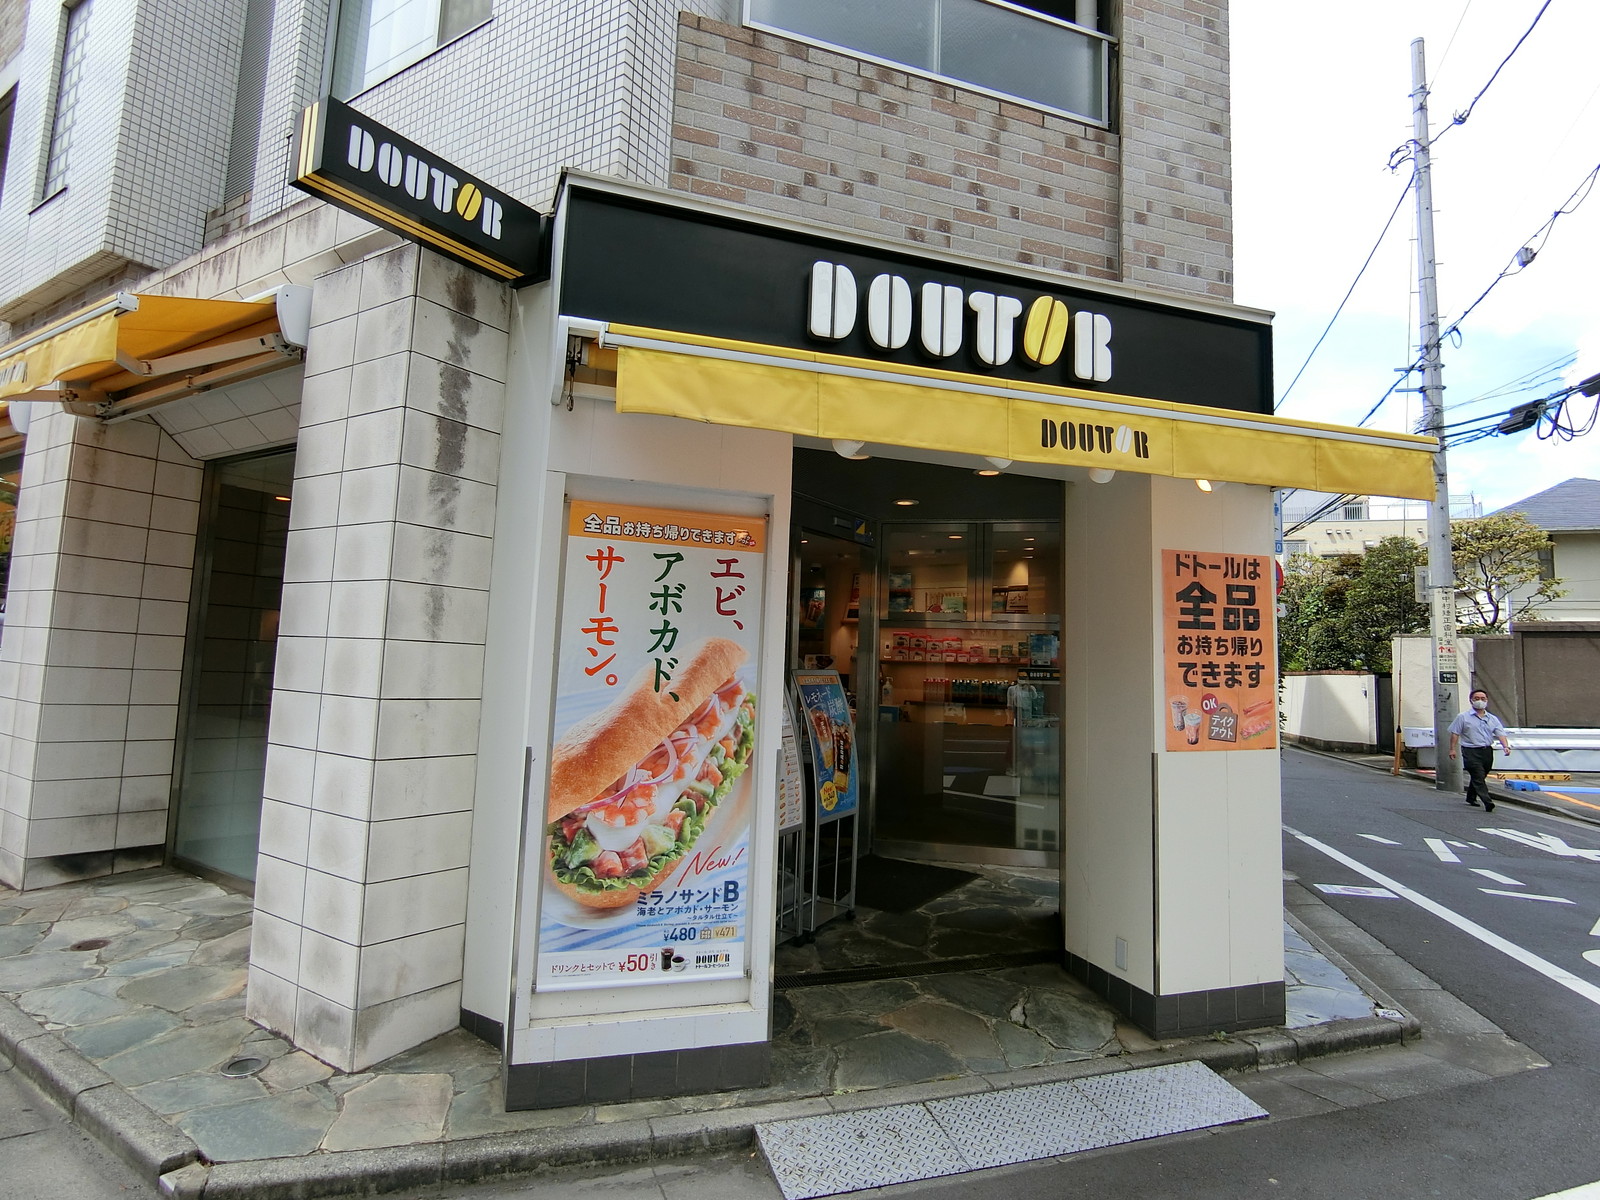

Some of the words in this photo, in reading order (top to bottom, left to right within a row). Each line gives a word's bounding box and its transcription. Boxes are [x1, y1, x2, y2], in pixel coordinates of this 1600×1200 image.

[347, 124, 503, 241] DOUTOR
[808, 260, 1113, 383] DOUTOR
[1041, 418, 1150, 459] DOUTOR
[584, 513, 736, 545] 全品お持ち帰りできます
[1175, 553, 1261, 580] ドトールは
[710, 558, 746, 631] エビ、
[1175, 581, 1261, 632] 全品
[581, 545, 626, 687] サーモン。
[646, 552, 687, 702] アボカド、
[1177, 634, 1264, 657] お持ち帰り
[1177, 661, 1266, 689] できます
[1203, 697, 1217, 711] OK
[1211, 714, 1235, 727] テイク
[1211, 727, 1234, 739] アウト
[677, 845, 745, 888] New!
[637, 880, 740, 906] ミラノサンドB
[663, 927, 697, 942] ¥480
[551, 961, 616, 974] ドリンクとセットで
[618, 953, 649, 972] ¥50
